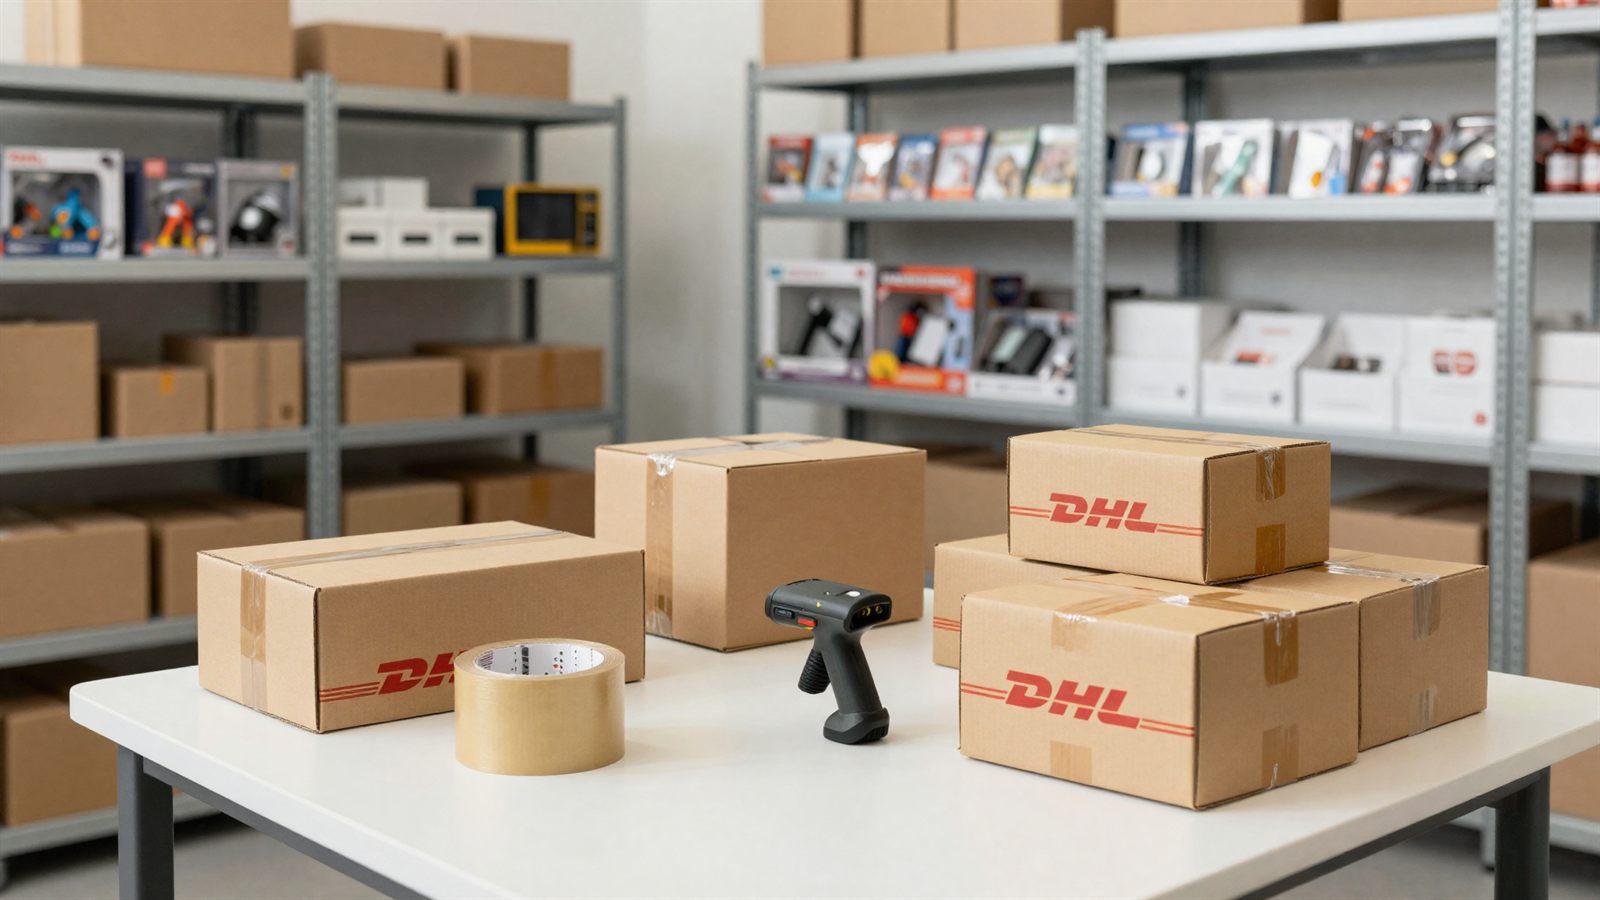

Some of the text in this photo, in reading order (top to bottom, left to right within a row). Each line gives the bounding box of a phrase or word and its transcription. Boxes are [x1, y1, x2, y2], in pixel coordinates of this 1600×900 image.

[1050, 492, 1158, 534] DHL
[377, 650, 467, 695] DH
[1005, 669, 1141, 730] DHL
